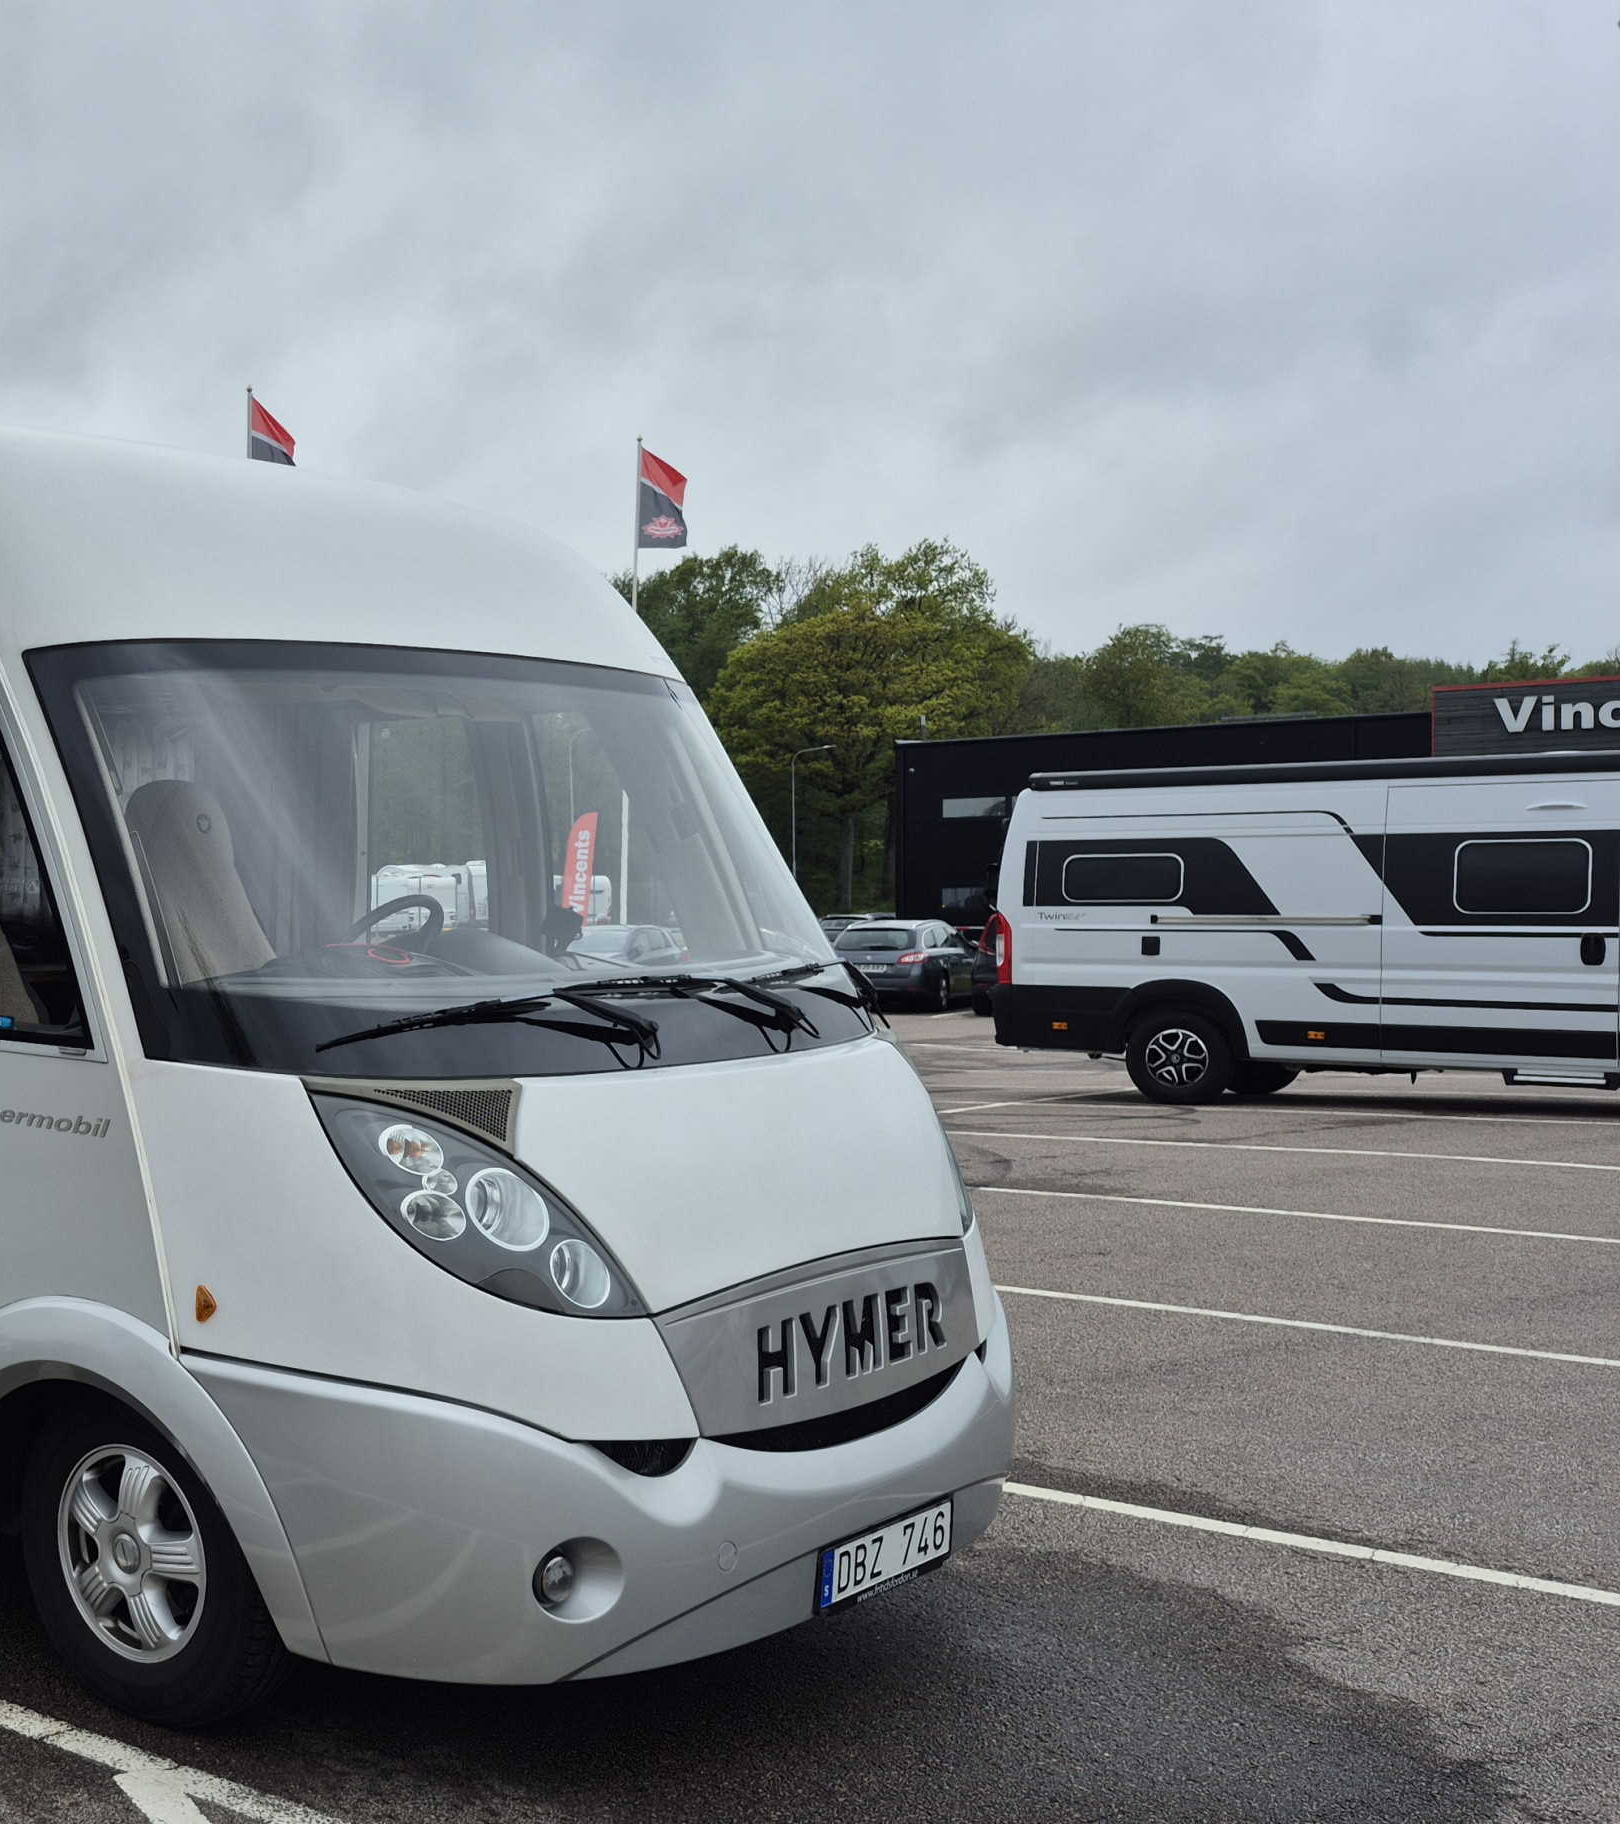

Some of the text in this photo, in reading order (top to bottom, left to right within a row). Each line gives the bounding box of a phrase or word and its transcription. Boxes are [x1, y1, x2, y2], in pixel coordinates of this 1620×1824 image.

[756, 1281, 948, 1407] HYMER
[822, 1584, 830, 1597] S
[837, 1510, 946, 1595] DBZ 746
